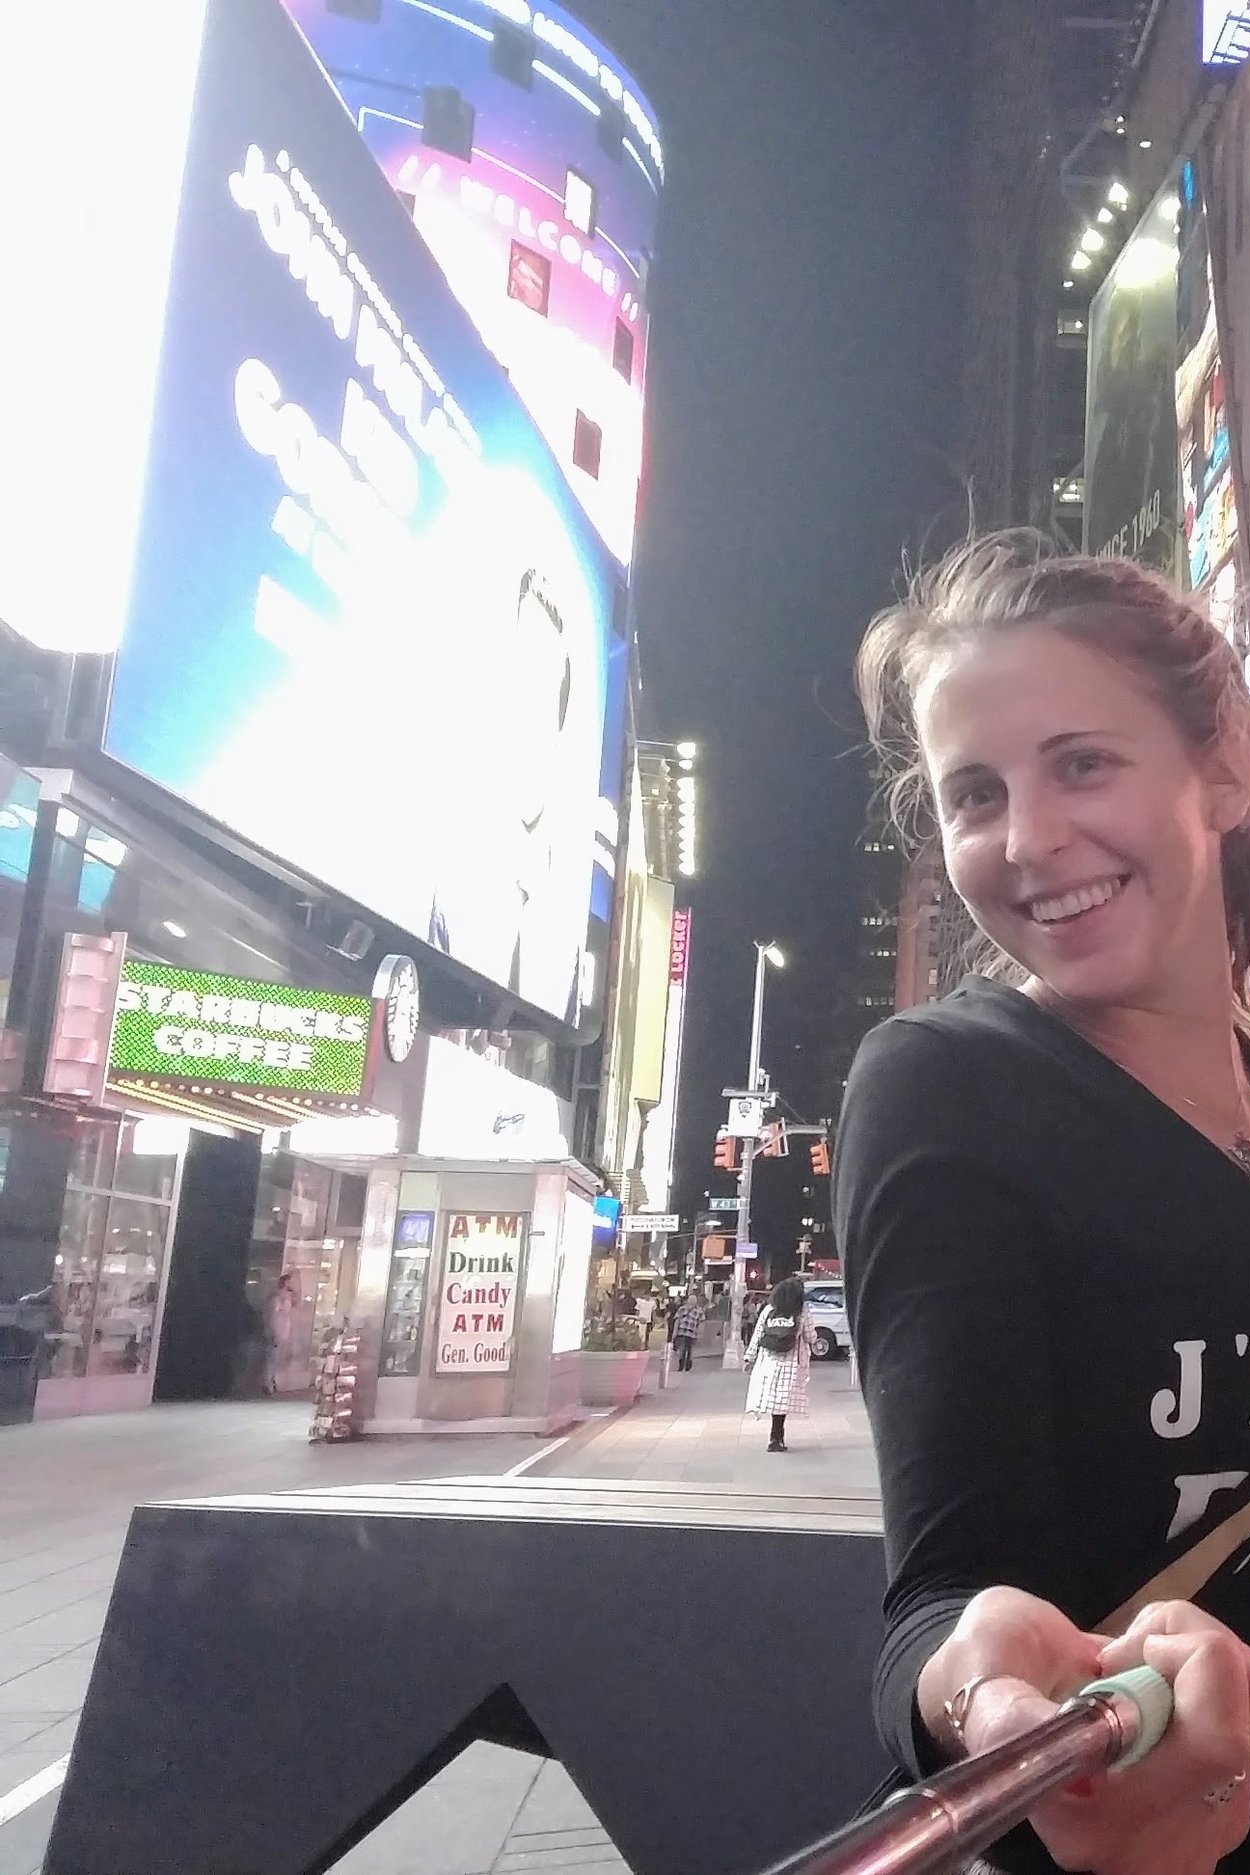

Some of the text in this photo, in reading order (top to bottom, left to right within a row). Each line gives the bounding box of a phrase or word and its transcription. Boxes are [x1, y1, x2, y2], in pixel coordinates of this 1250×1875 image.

[117, 981, 366, 1042] STARBUCKS
[153, 1024, 316, 1072] COFFEE
[450, 1215, 519, 1239] ATM
[448, 1251, 514, 1274] Drink
[446, 1282, 511, 1309] Candy
[451, 1313, 505, 1333] ATM
[440, 1342, 470, 1364] Gen.
